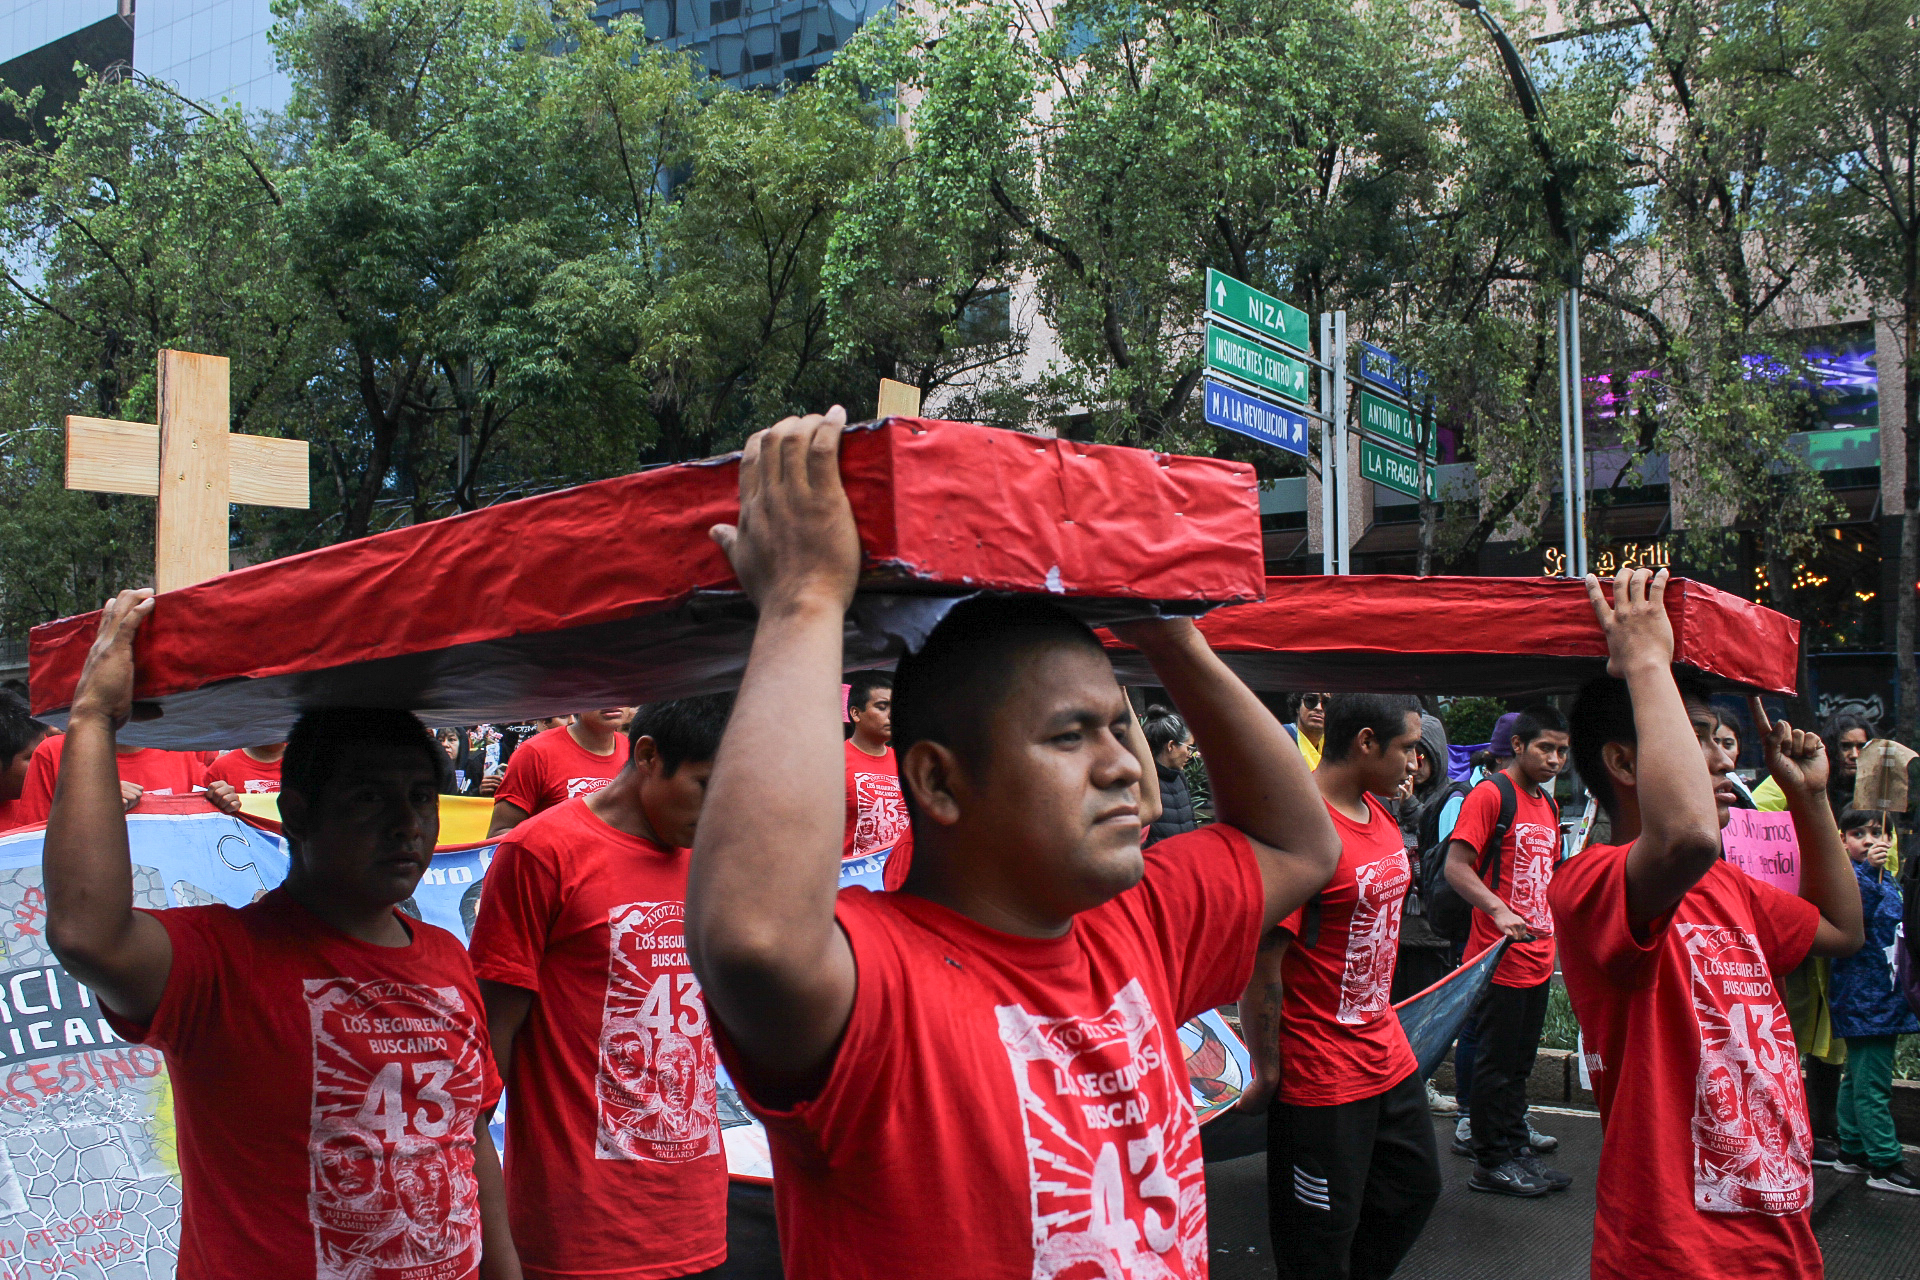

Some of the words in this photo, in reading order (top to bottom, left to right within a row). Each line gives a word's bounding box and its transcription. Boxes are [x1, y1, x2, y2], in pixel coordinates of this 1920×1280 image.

[1249, 296, 1286, 333] NIZA
[1215, 336, 1263, 377] INSURGENTES
[1264, 356, 1290, 387] CENTRO
[1213, 391, 1220, 416] M
[1222, 395, 1229, 419] A
[1231, 398, 1243, 424] LA
[1243, 403, 1289, 441] REVOLUCION
[1367, 402, 1400, 435] ANTONIO
[1403, 417, 1423, 444] CAO
[1368, 450, 1383, 475] LA
[870, 797, 898, 823] 43
[1527, 855, 1553, 886] 43
[1372, 884, 1383, 895] LOS
[1368, 896, 1403, 946] 43
[635, 935, 656, 950] LOS
[1704, 961, 1724, 976] LOS
[634, 973, 707, 1040] 43
[342, 1017, 371, 1034] LOS
[1723, 1003, 1783, 1075] 43
[368, 1036, 448, 1054] BUSCANDO
[355, 1059, 457, 1144] 43
[655, 1150, 695, 1158] GALLARDO
[1088, 1123, 1181, 1276] 43
[40, 1237, 135, 1274] OLVIDO
[401, 1266, 436, 1280] DANIEL
